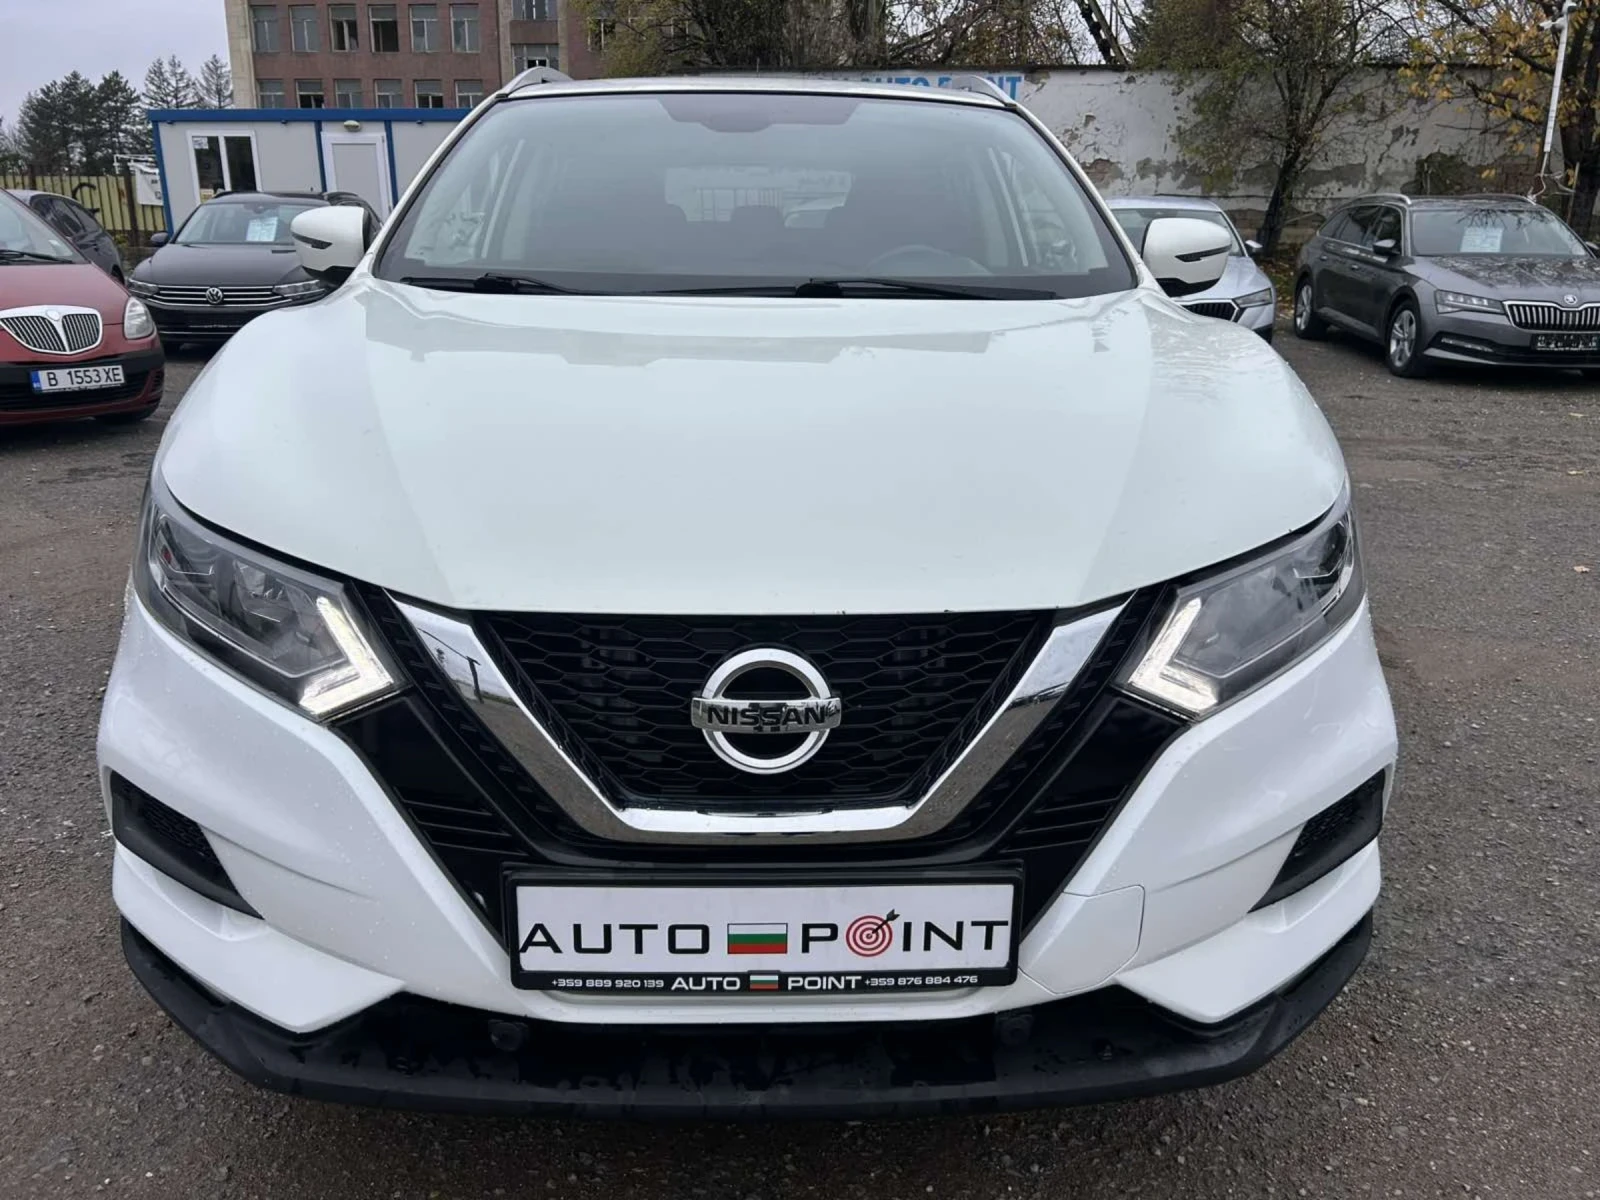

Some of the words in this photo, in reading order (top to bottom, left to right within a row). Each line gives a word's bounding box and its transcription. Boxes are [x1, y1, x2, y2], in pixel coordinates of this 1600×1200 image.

[47, 372, 58, 387] B
[67, 369, 102, 385] 1553
[103, 367, 122, 382] XE
[707, 705, 825, 726] NISSAN
[518, 922, 710, 955] AUTO
[552, 978, 583, 987] +359
[586, 979, 612, 987] 889
[615, 979, 641, 988] 920
[644, 979, 665, 988] 139
[671, 977, 741, 990] AUTO
[788, 976, 862, 990] POINT
[865, 977, 895, 986] +359
[897, 976, 922, 985] 876
[925, 976, 951, 985] 884
[954, 975, 979, 983] 476
